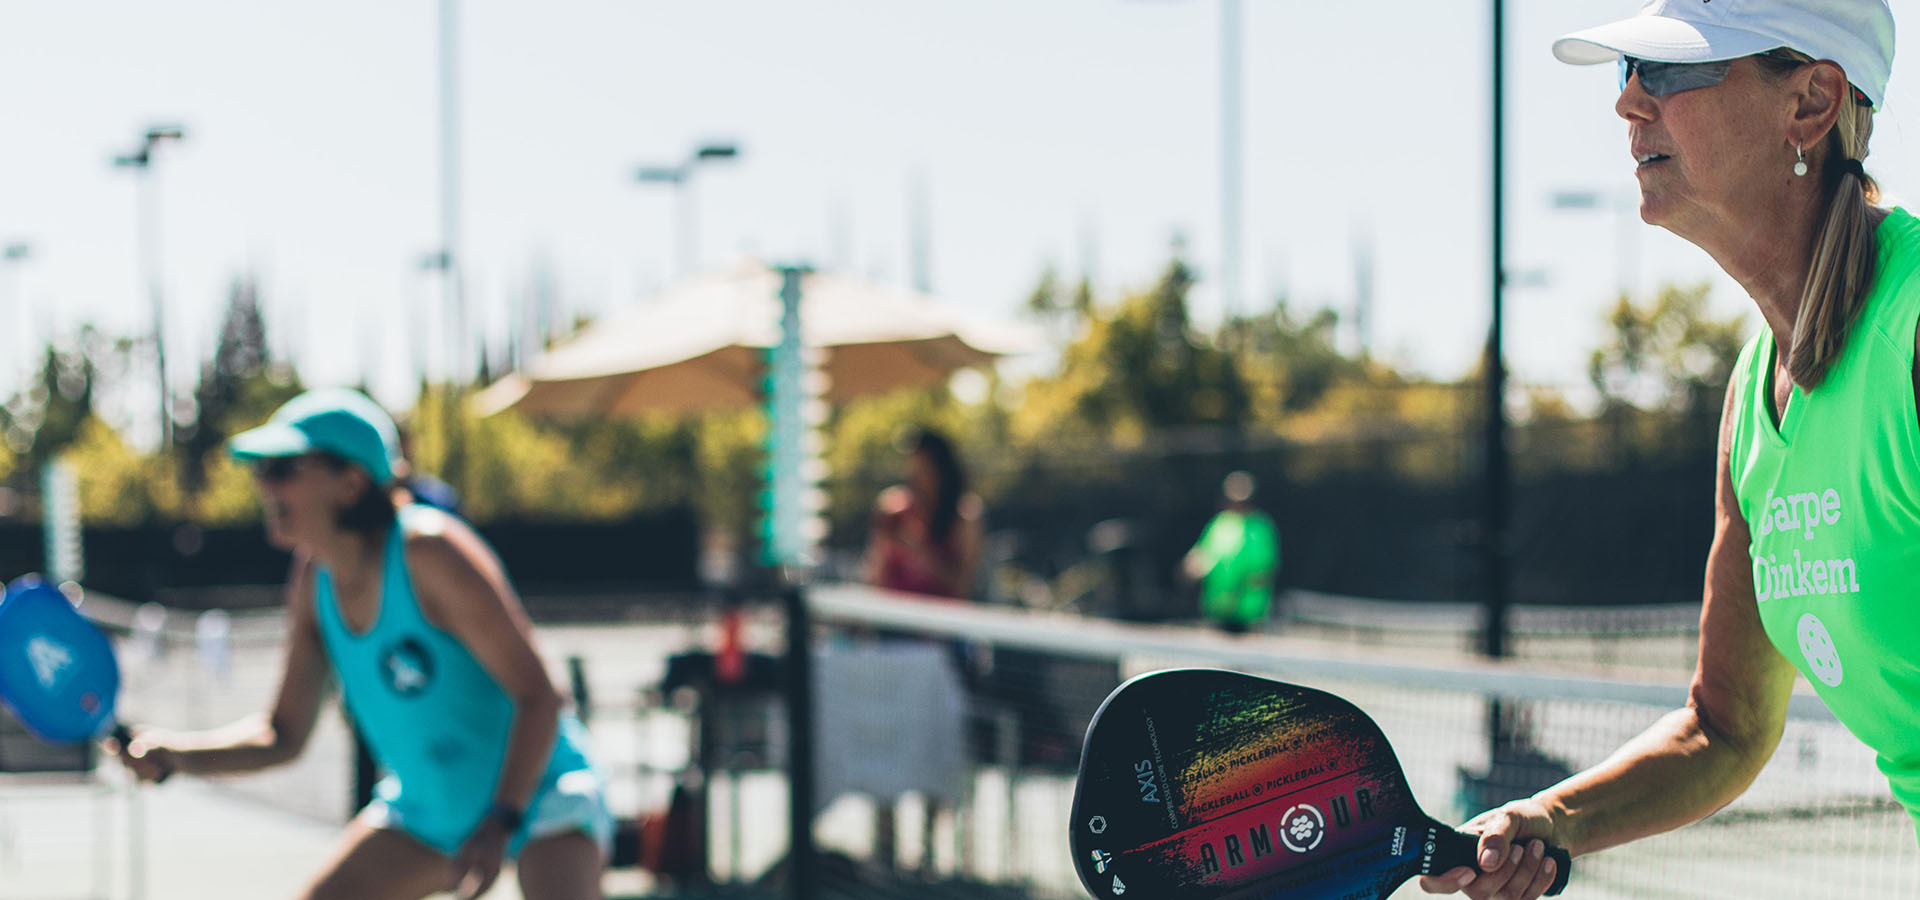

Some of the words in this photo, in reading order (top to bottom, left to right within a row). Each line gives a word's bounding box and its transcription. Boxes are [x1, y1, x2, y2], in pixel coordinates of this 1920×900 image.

[1754, 549, 1860, 602] Dinkem
[1230, 742, 1288, 768] PICKLEBALL
[1134, 759, 1160, 803] AXIS
[1191, 790, 1250, 816] PICKLEBALL
[1266, 764, 1324, 790] PICKLEBALL
